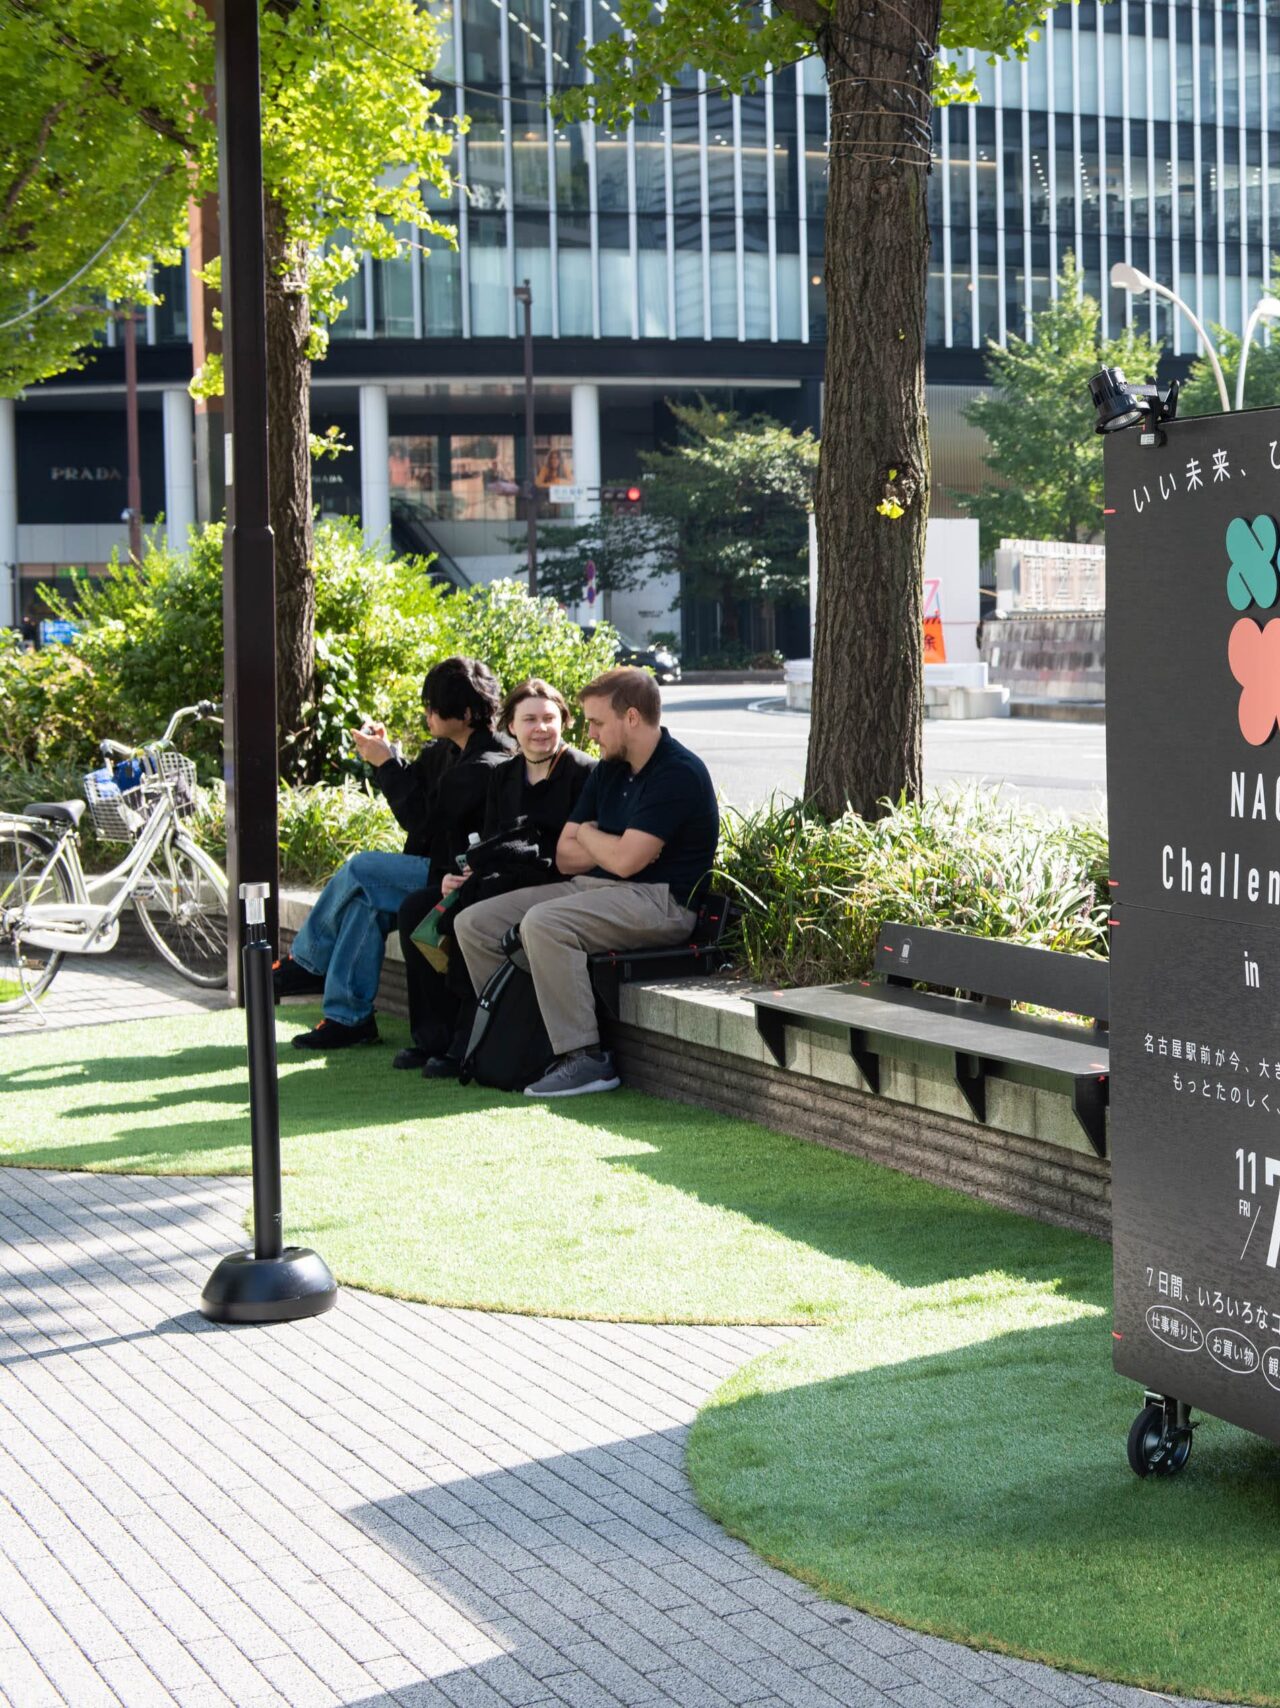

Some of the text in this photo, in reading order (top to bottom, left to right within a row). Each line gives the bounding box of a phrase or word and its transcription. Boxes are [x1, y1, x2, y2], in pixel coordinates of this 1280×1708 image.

[51, 467, 121, 481] PRADA
[1244, 951, 1260, 988] in
[1239, 1199, 1250, 1217] FRI
[1151, 1312, 1199, 1345] 仕事帰りに
[1213, 1334, 1255, 1367] お買い物
